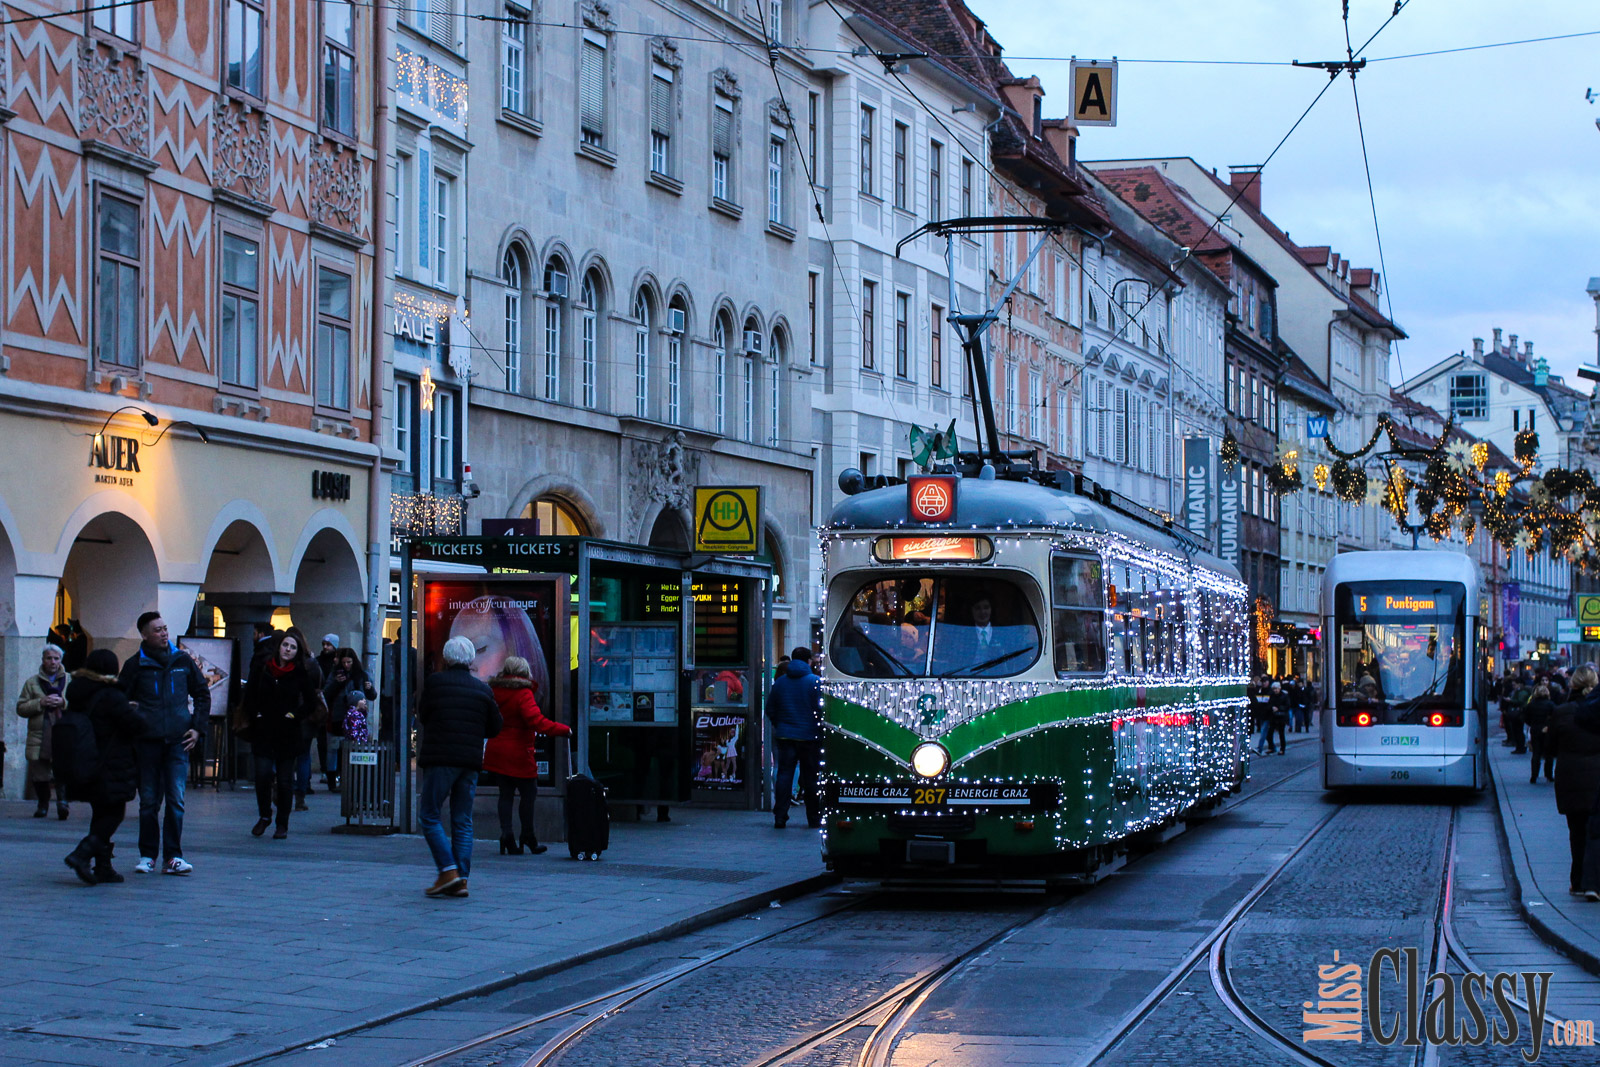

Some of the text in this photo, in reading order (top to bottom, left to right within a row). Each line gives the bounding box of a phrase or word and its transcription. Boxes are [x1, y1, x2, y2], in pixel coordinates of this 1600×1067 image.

[1079, 73, 1107, 115] A
[88, 434, 140, 472] AUER
[95, 474, 134, 487] MARTIN AUER
[713, 501, 739, 520] HH
[1221, 479, 1238, 564] HUMANIC
[430, 543, 561, 555] TICKETS TICKETS
[903, 537, 961, 553] einsteigen
[508, 600, 538, 610] mayer
[1360, 596, 1435, 612] 5 Puntigam
[1381, 736, 1419, 746] GRAZ
[1391, 770, 1410, 780] 206
[843, 787, 909, 797] ENERGIE GRAZ
[914, 788, 945, 804] 267
[955, 788, 1028, 798] ENERGIE GRAZ
